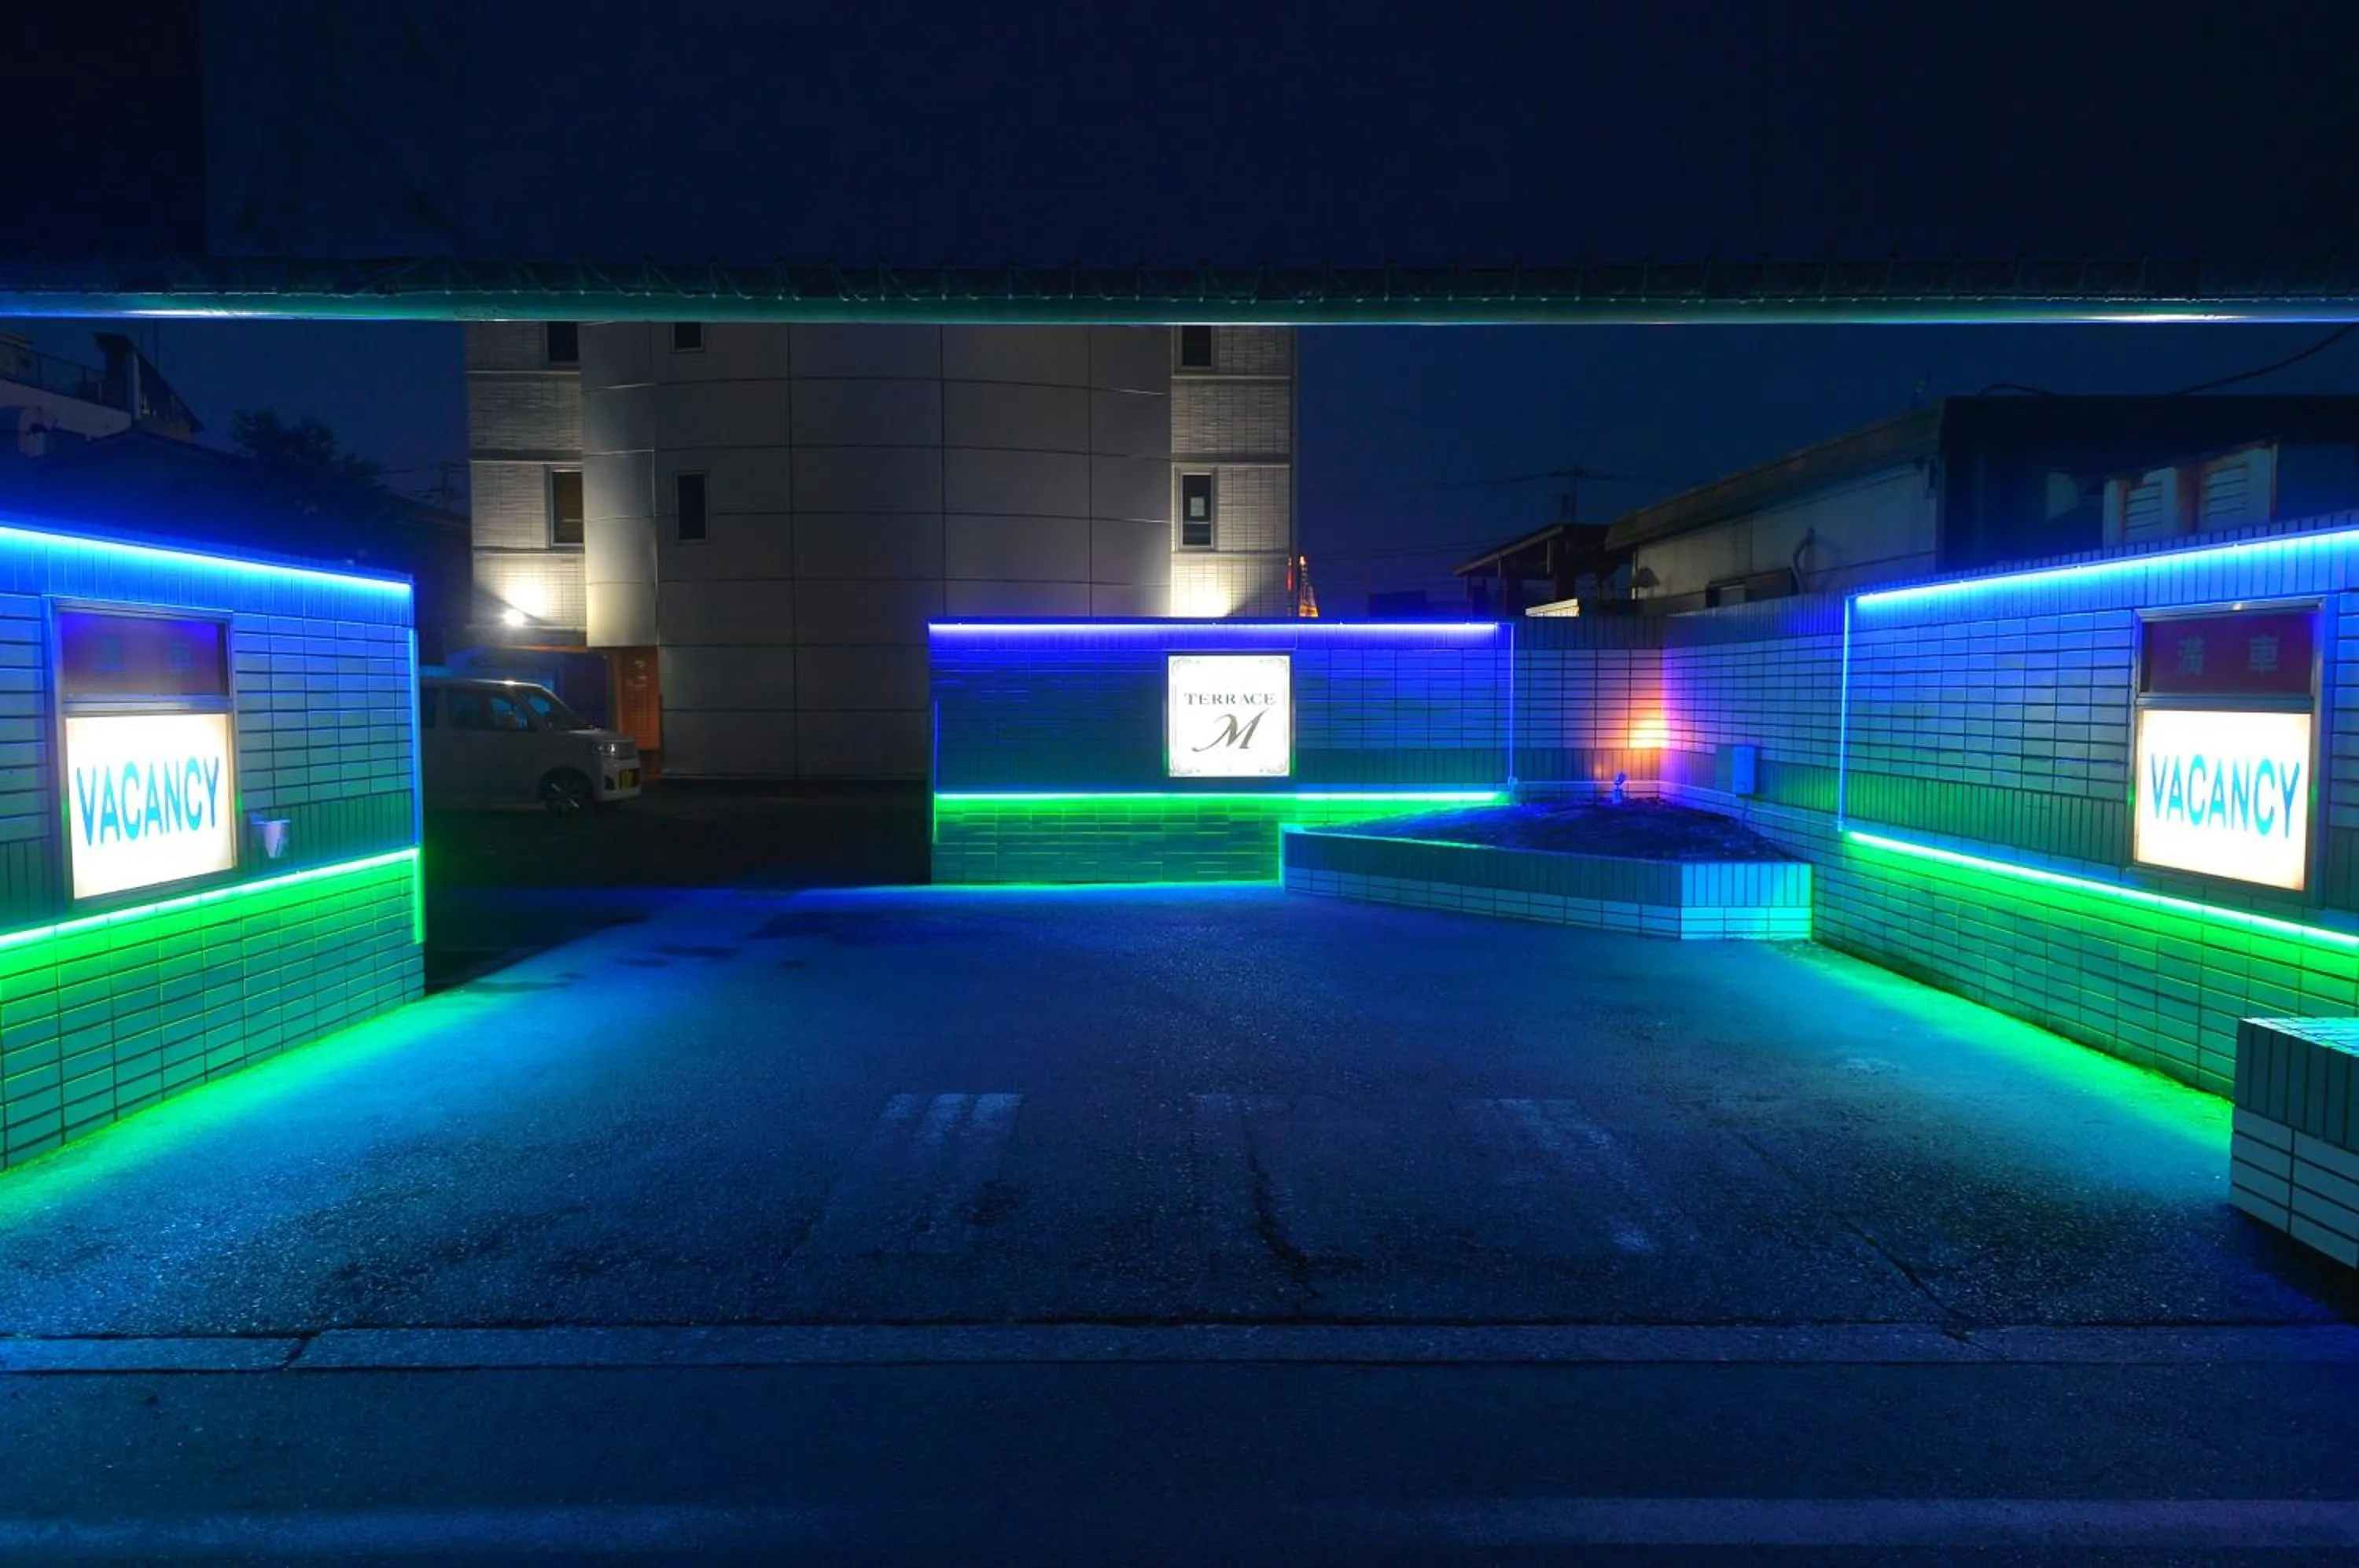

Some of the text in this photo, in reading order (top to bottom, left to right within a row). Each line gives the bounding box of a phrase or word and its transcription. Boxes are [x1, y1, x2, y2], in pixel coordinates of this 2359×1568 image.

[1183, 692, 1277, 706] TERRACE
[1191, 707, 1271, 753] M
[76, 754, 219, 847] VACANCY
[2150, 752, 2301, 839] VACANCY
